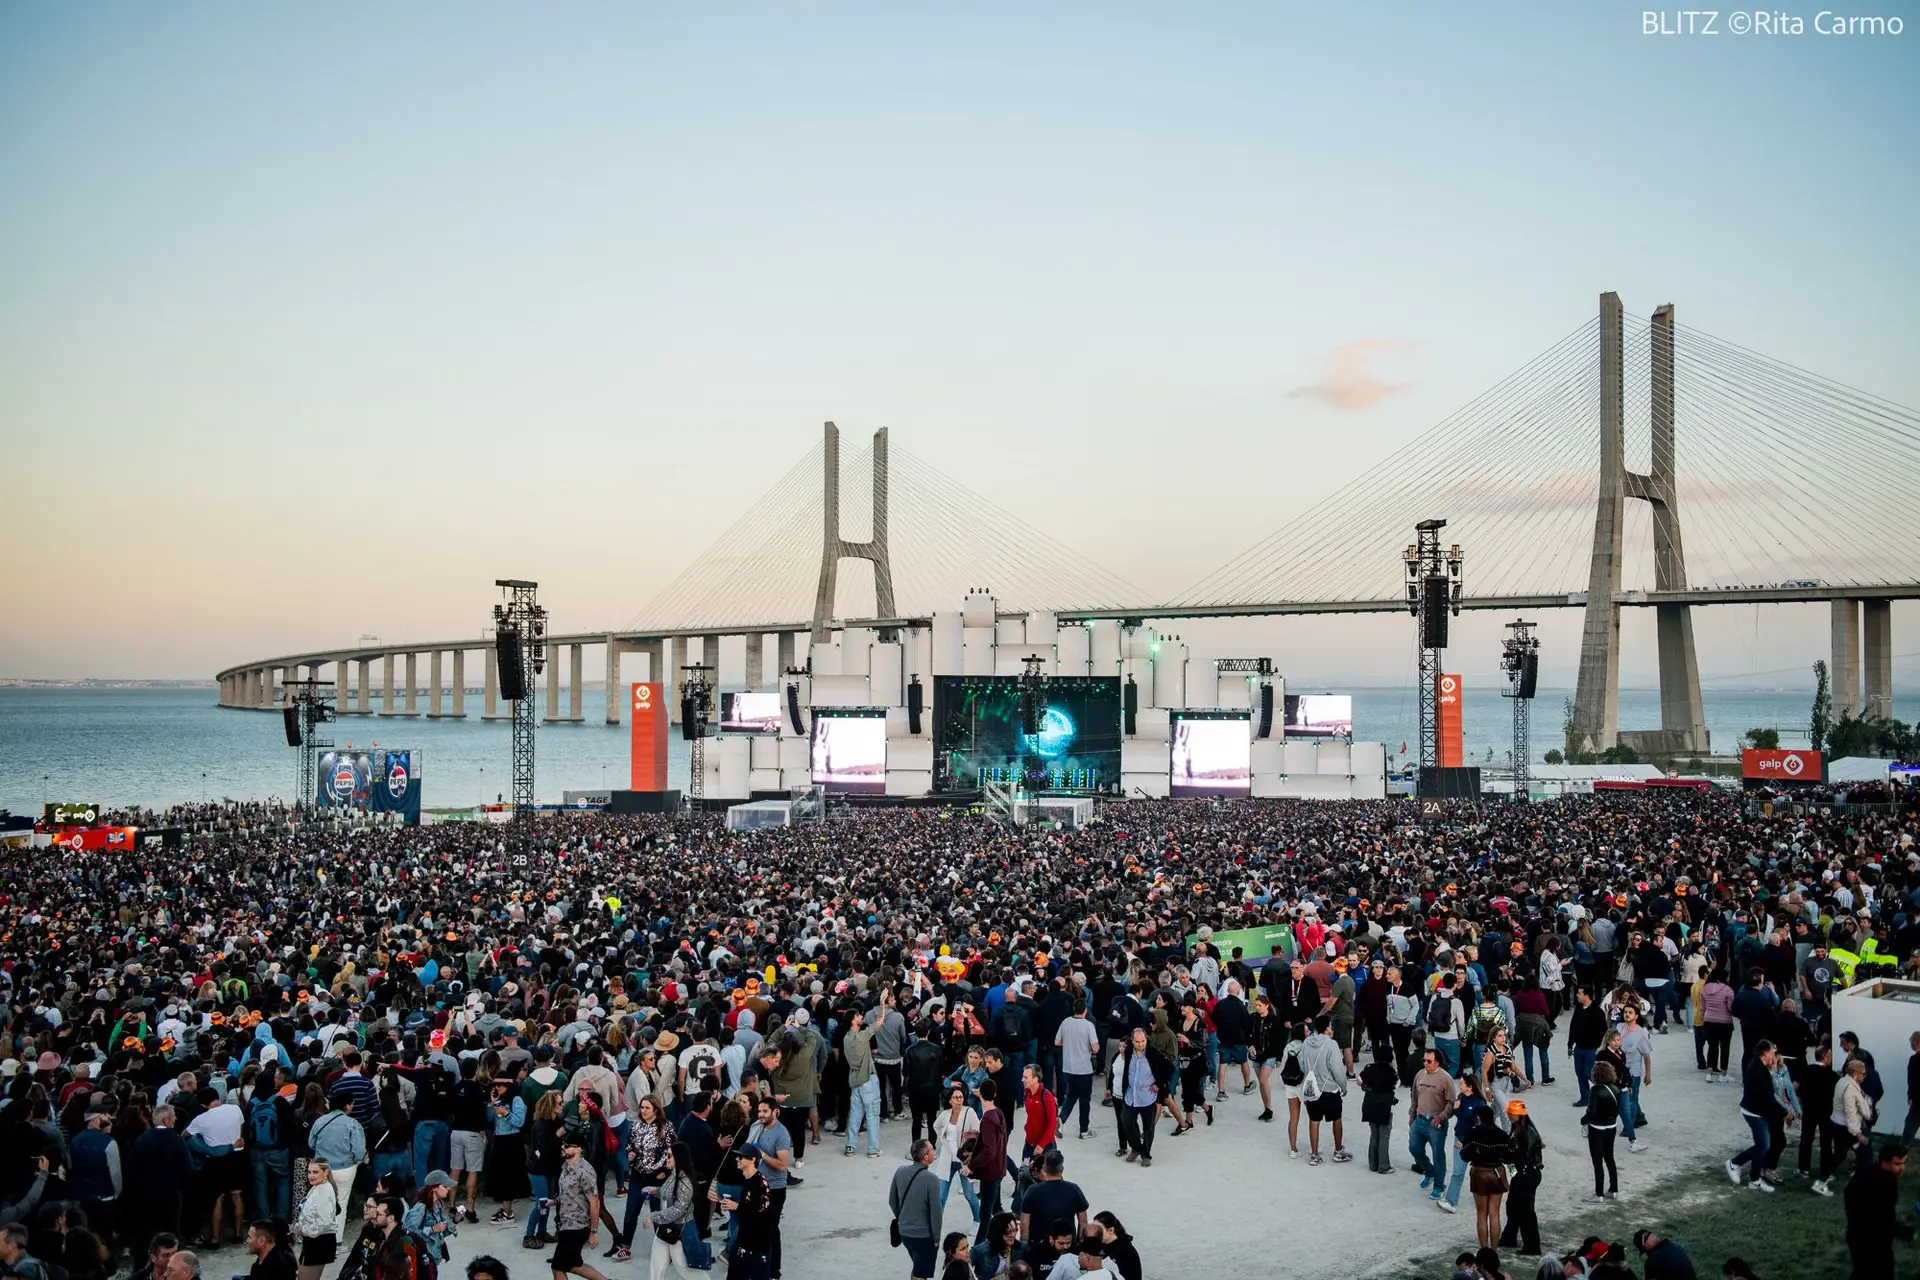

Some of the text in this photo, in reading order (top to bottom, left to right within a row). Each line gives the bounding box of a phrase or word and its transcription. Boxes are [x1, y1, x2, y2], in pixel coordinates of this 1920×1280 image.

[1759, 758, 1781, 770] galp
[584, 796, 608, 804] TAGE
[1424, 801, 1441, 813] 2A
[512, 854, 528, 866] 2B
